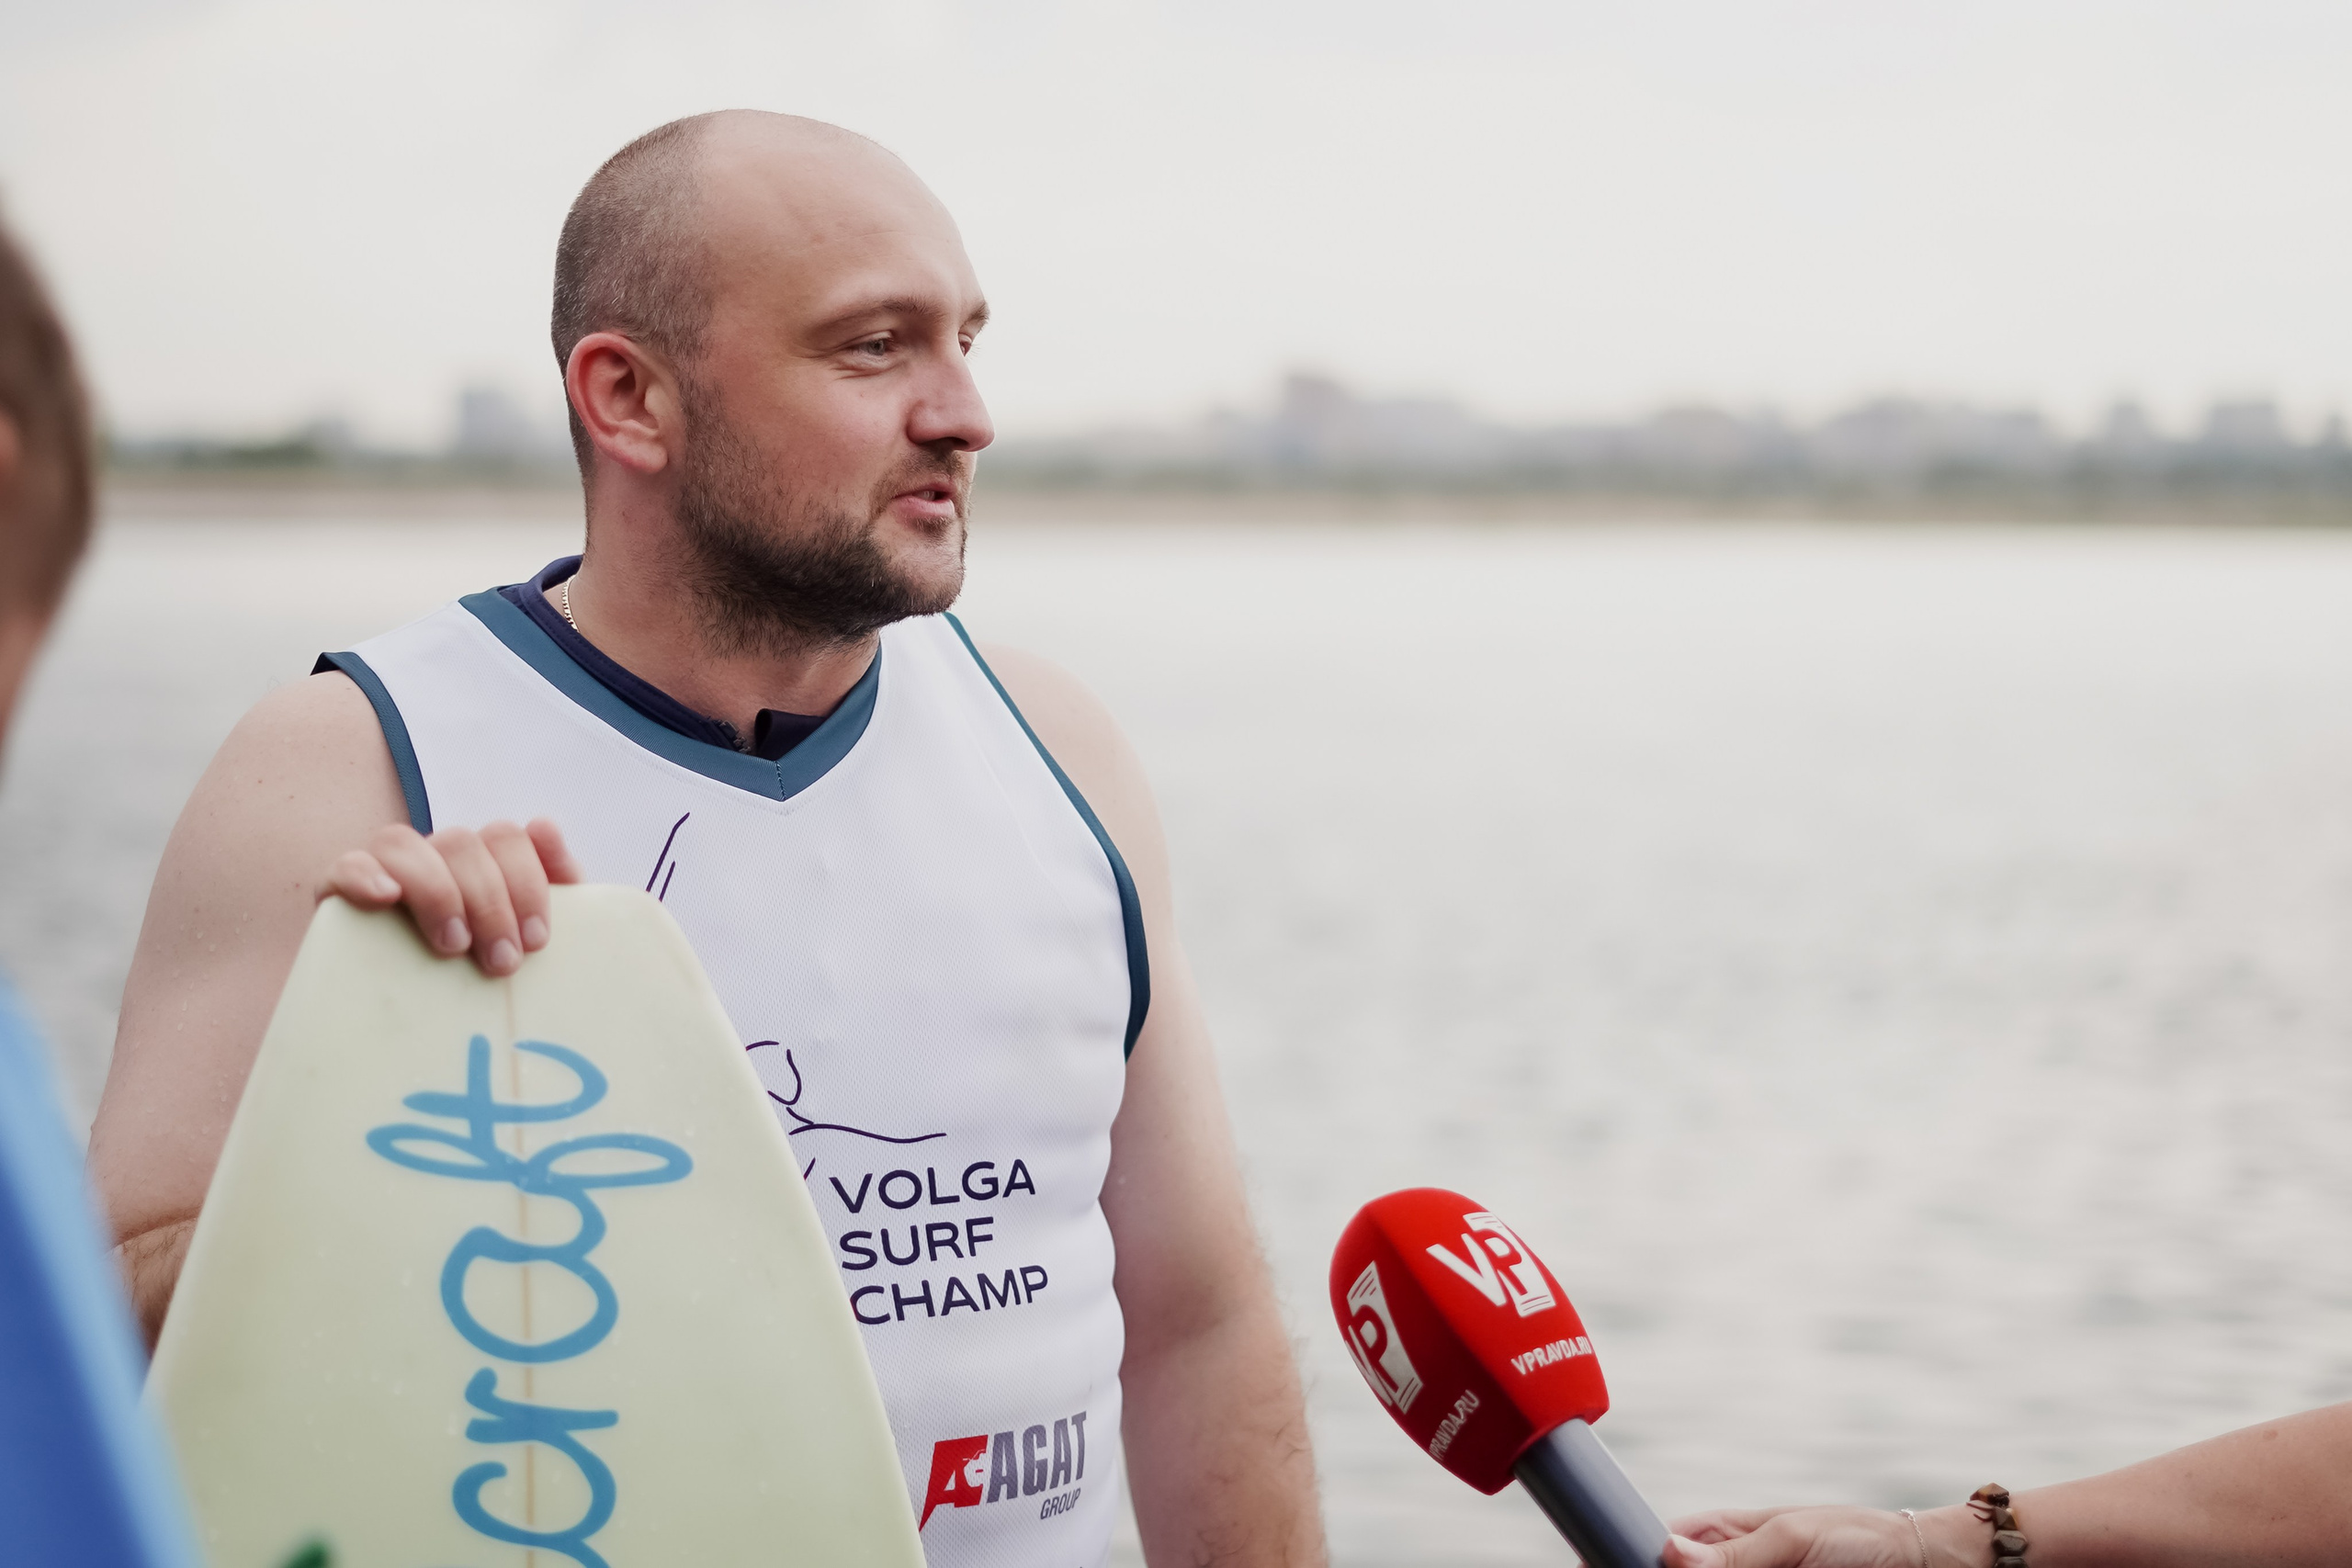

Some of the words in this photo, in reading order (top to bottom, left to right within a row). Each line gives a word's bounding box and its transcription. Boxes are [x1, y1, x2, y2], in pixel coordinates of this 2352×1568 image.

[829, 1158, 1036, 1213] VOLGA
[839, 1216, 994, 1270] SURF
[850, 1265, 1049, 1325] CHAMP
[1510, 1336, 1593, 1375] VPRAVDA.RU
[986, 1410, 1087, 1504] AGAT
[1039, 1487, 1081, 1520] GROUP
